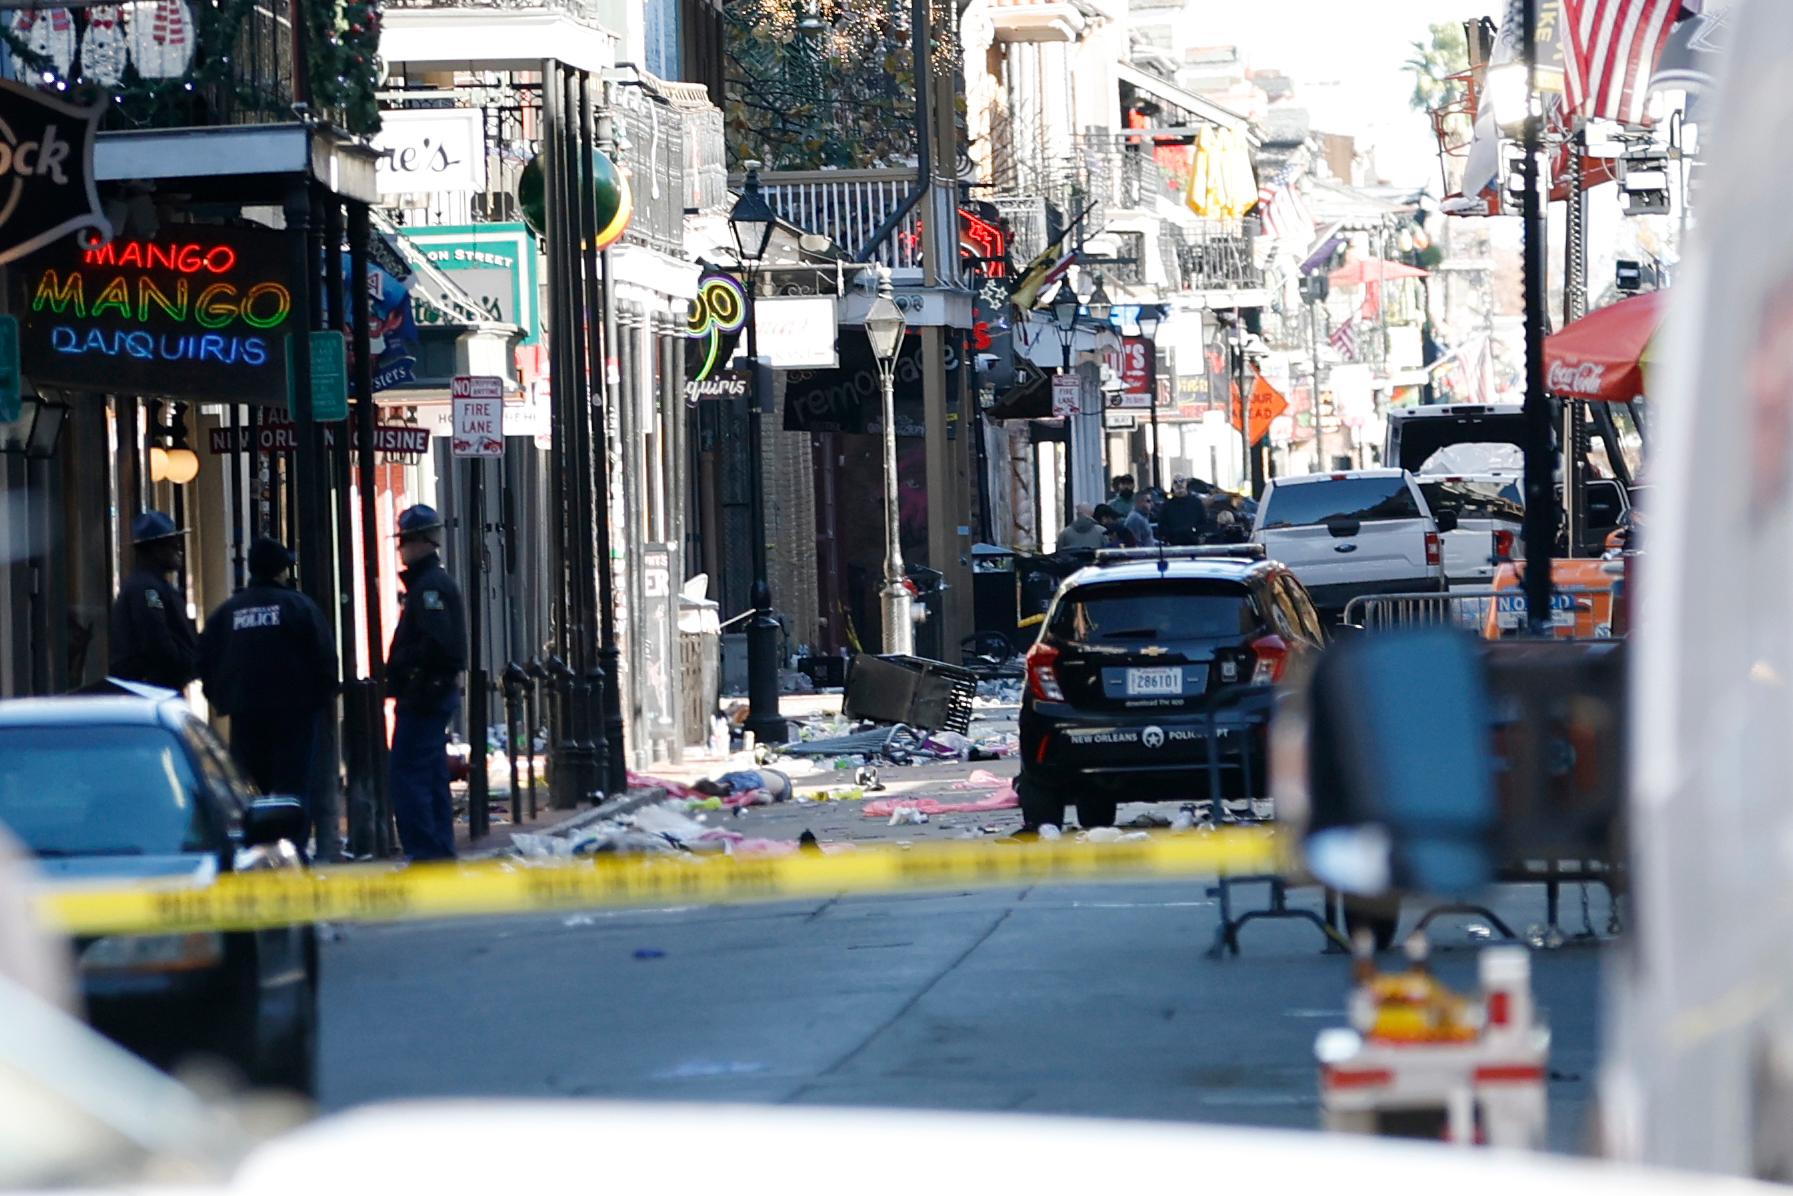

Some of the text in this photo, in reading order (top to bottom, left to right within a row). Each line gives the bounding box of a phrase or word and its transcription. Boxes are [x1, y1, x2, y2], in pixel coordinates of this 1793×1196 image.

[85, 238, 236, 273] MANGO
[455, 248, 513, 269] STREET
[32, 269, 291, 329] MANGO
[52, 327, 267, 365] DAIQUIRIS
[454, 380, 470, 396] NO
[684, 374, 747, 402] quiris
[464, 403, 491, 417] FIRE
[462, 421, 492, 434] LANE
[233, 612, 280, 630] POLICE
[1071, 735, 1093, 744] NEW
[1094, 733, 1138, 743] ORLEANS
